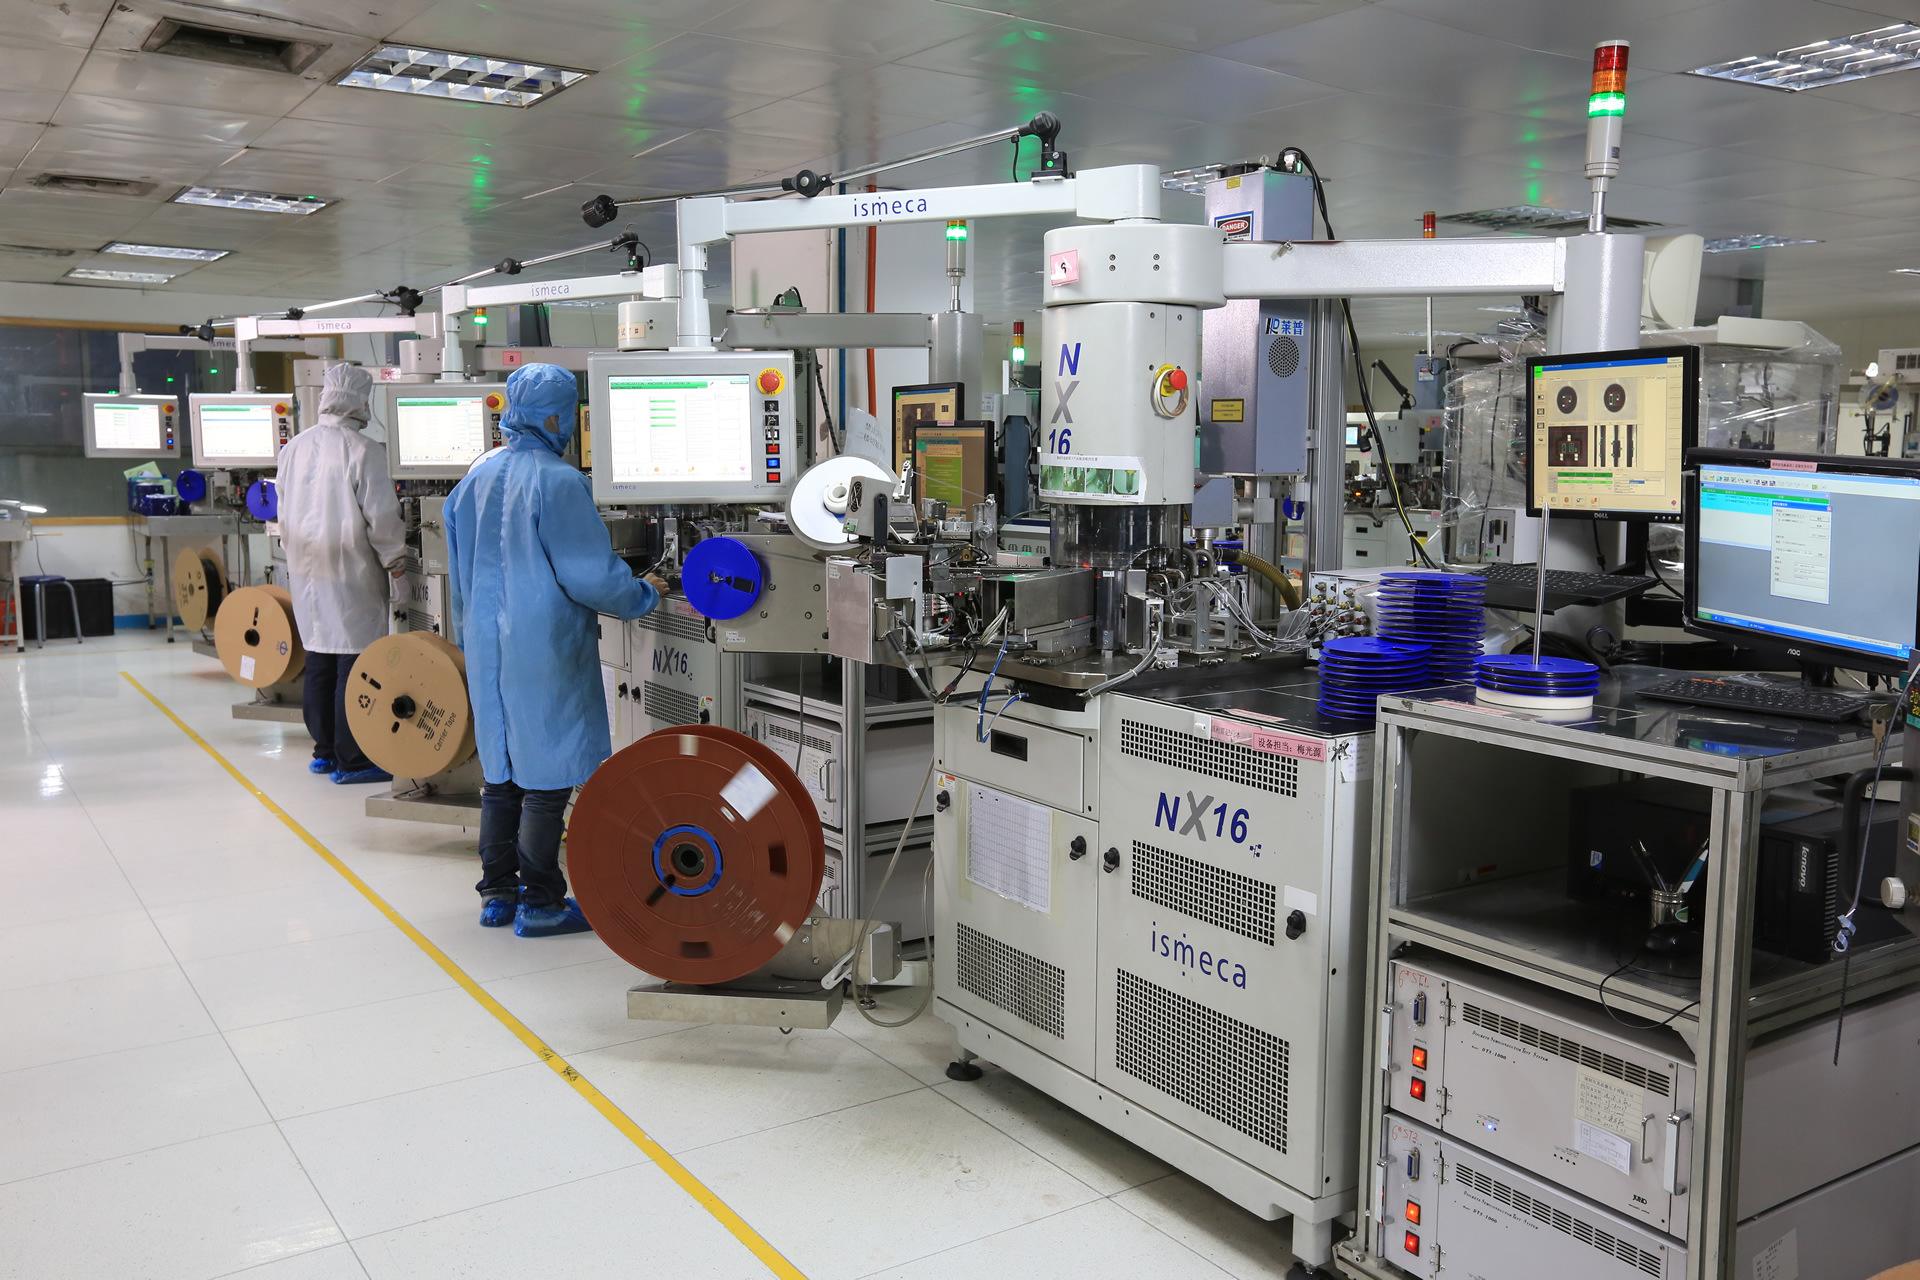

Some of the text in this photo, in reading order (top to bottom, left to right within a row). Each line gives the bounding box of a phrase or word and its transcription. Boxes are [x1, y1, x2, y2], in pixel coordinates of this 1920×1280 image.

[853, 196, 928, 220] ismeca
[531, 284, 570, 297] ismeca
[317, 321, 352, 330] ismeca
[653, 645, 688, 676] NX16
[433, 711, 457, 751] Carrier Tape
[1154, 789, 1250, 845] NX16
[1800, 846, 1810, 888] lenovo
[1151, 920, 1248, 990] ismeca
